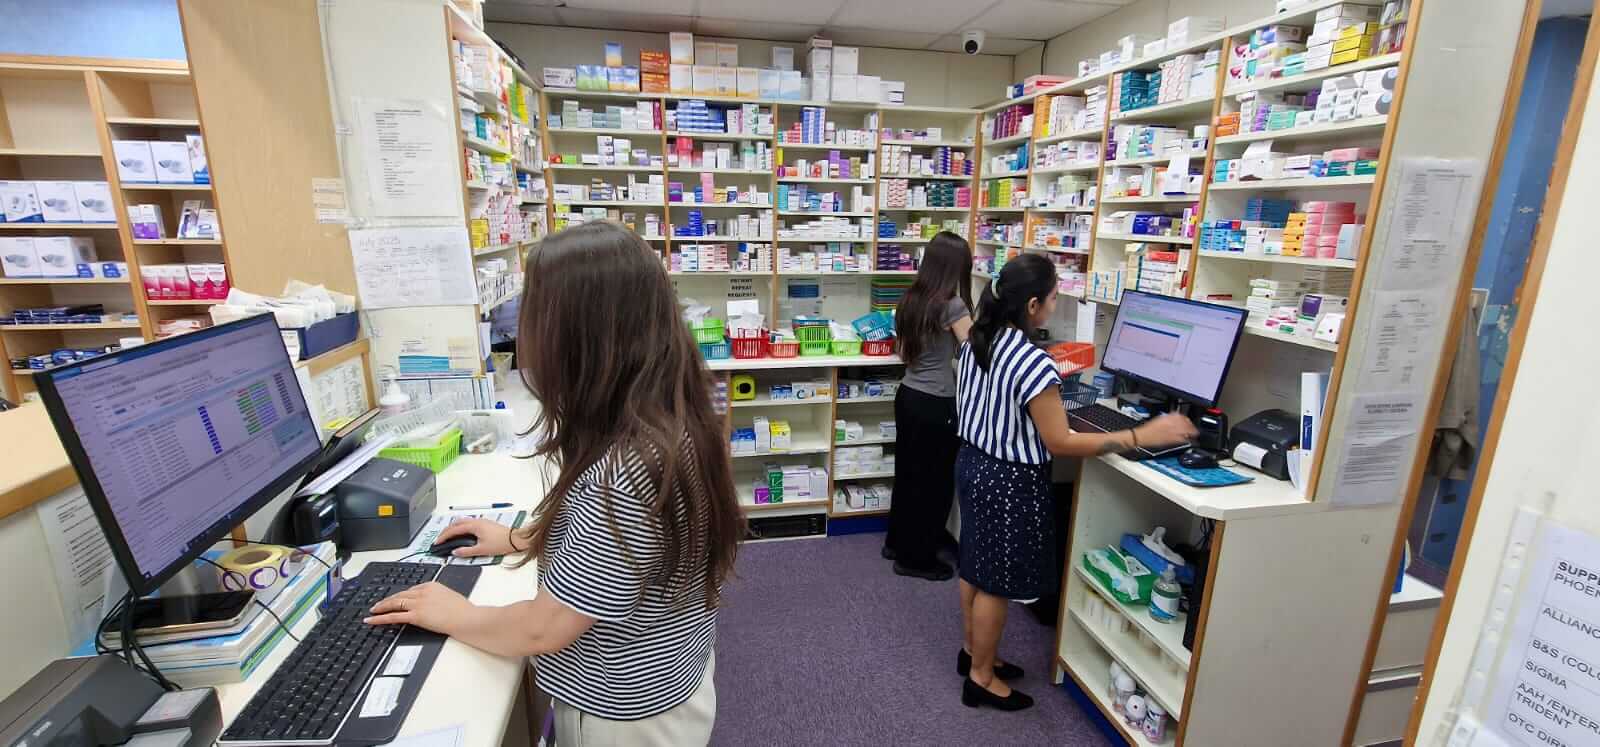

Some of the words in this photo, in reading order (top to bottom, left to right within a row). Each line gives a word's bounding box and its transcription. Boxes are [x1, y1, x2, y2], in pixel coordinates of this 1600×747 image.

[1558, 561, 1600, 586] SUPP
[1532, 640, 1559, 658] B&S
[1525, 661, 1567, 689] SIGMA
[1516, 691, 1573, 729] TRIDENT
[1518, 683, 1545, 702] AAH
[1547, 699, 1600, 735] /ENTER
[1508, 712, 1535, 734] OTC
[1537, 730, 1567, 747] DIR
